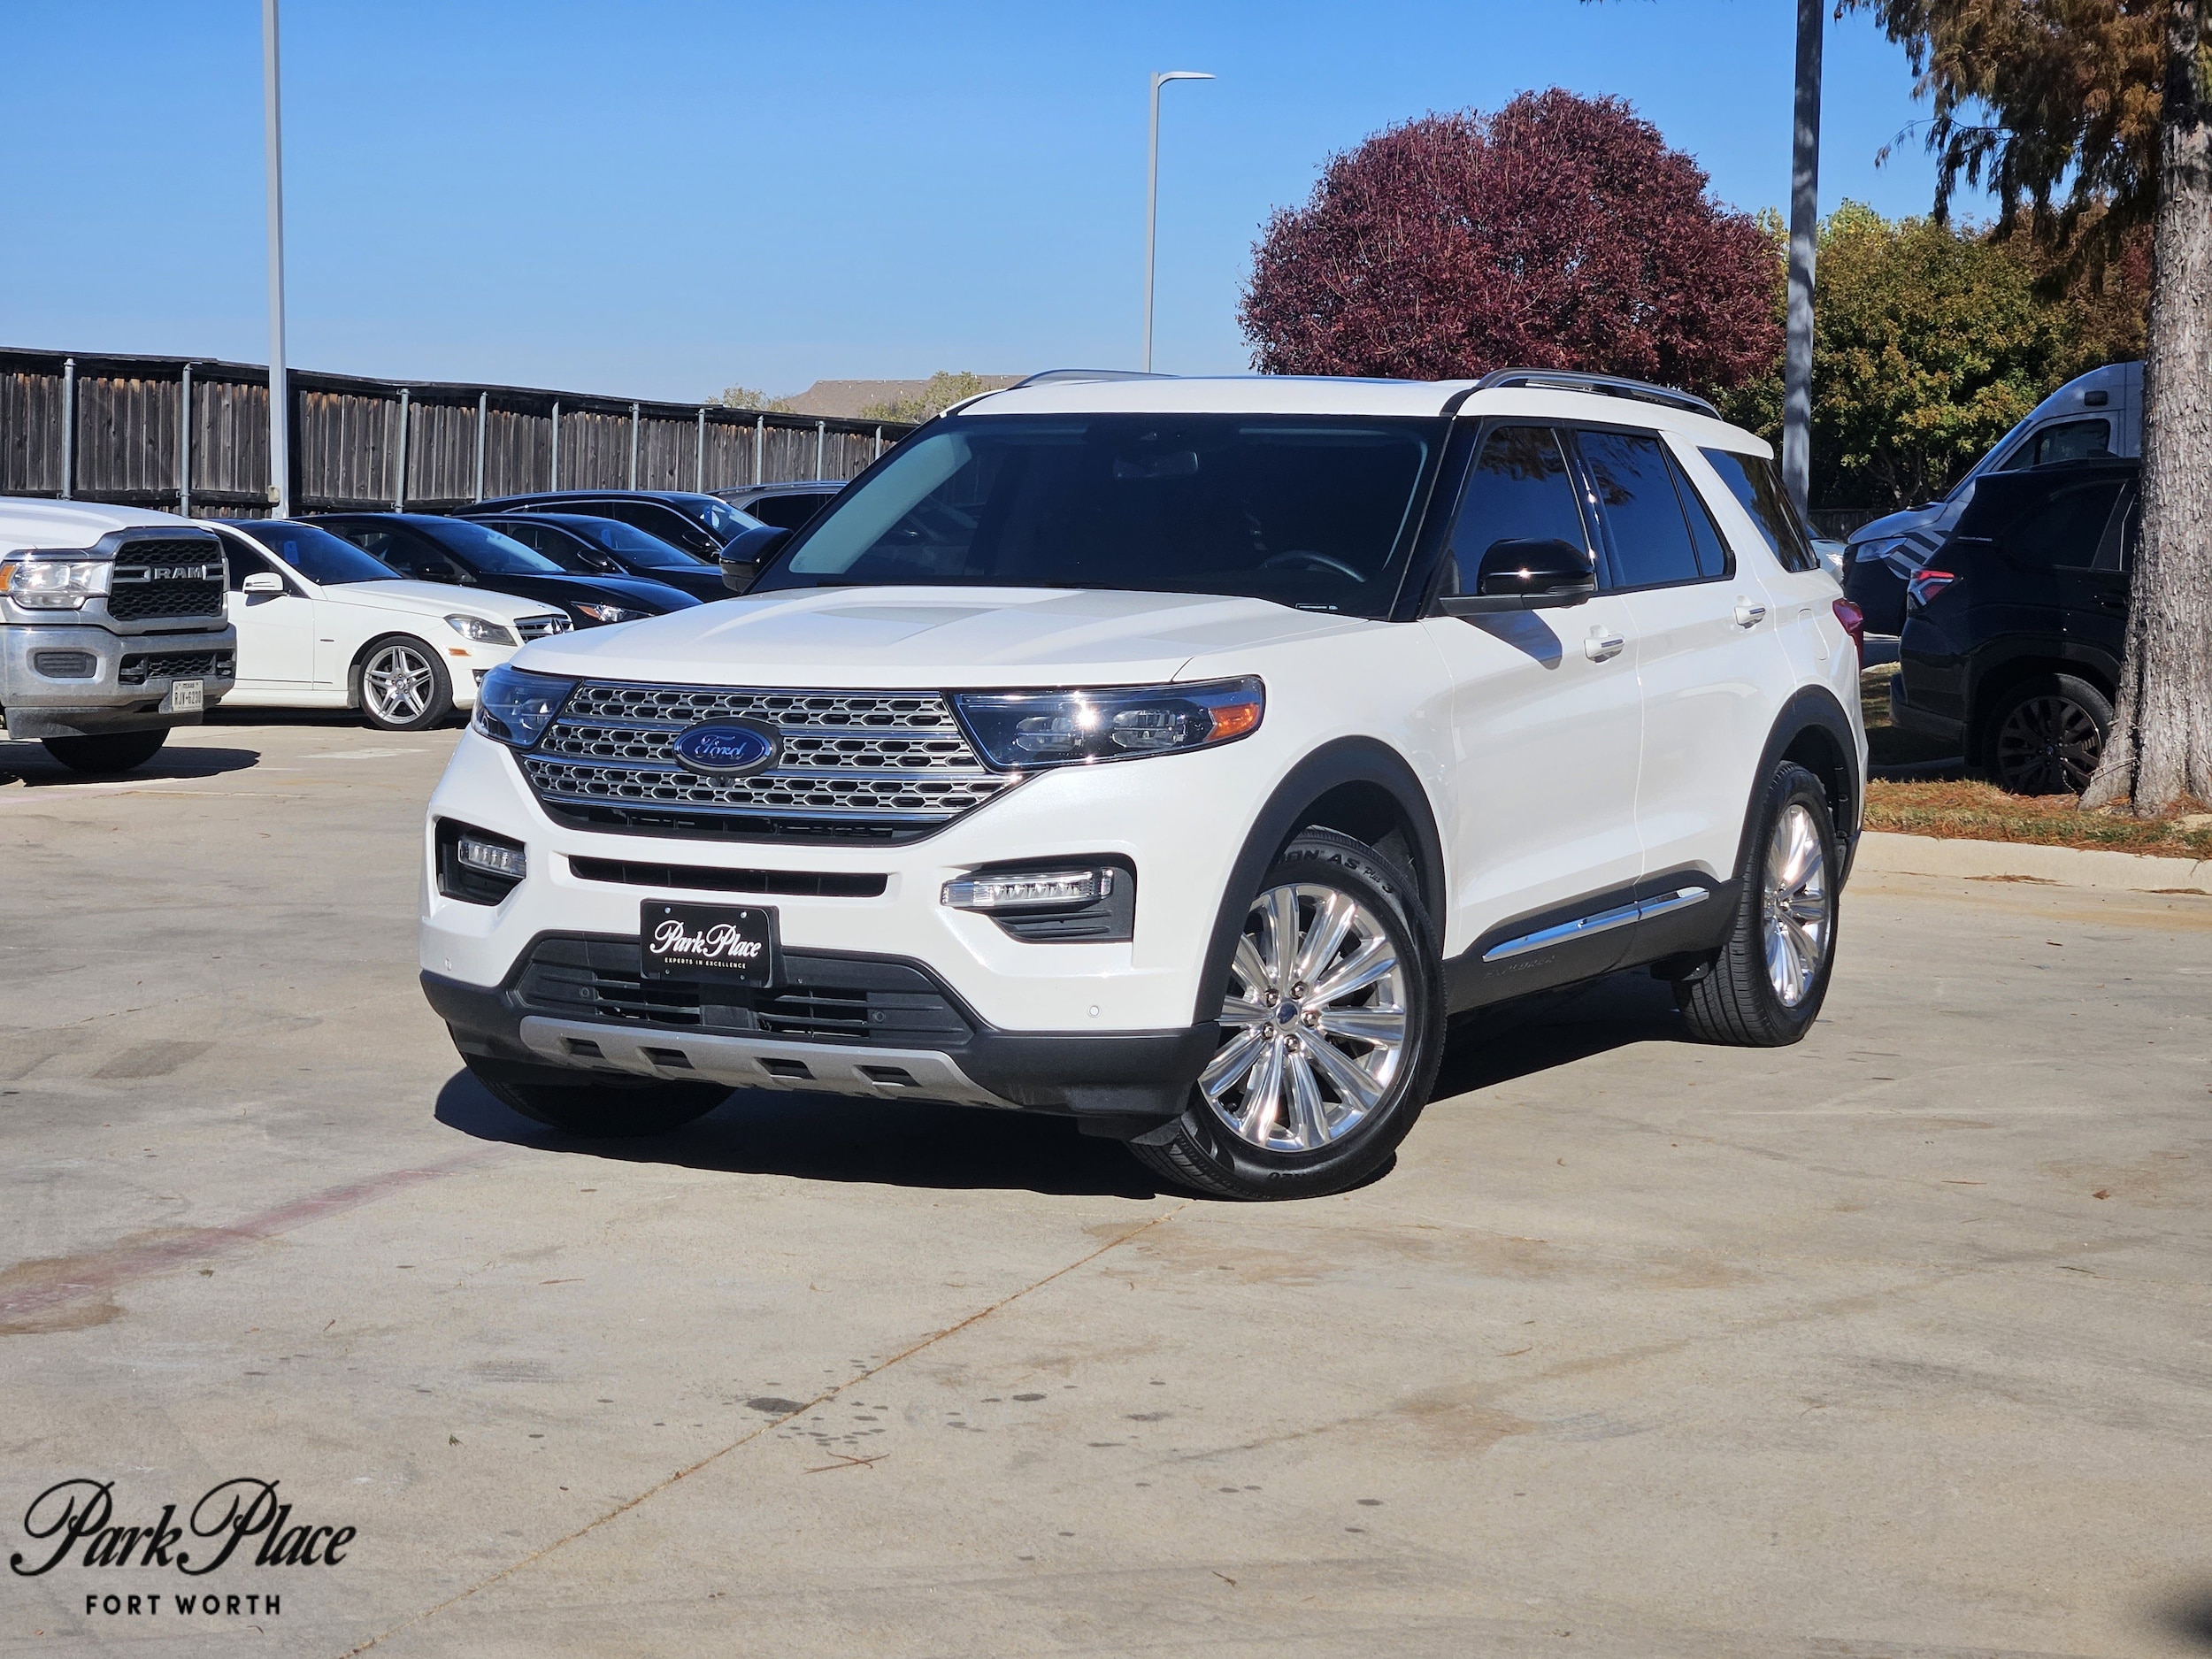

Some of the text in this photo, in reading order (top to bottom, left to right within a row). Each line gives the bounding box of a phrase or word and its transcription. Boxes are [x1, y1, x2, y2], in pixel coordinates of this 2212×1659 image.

[154, 567, 203, 580] RAM
[695, 735, 747, 759] Ford
[1328, 854, 1360, 870] AS
[1363, 866, 1381, 883] Plus
[649, 920, 762, 957] Park Place
[705, 960, 746, 970] EXCELLENCE
